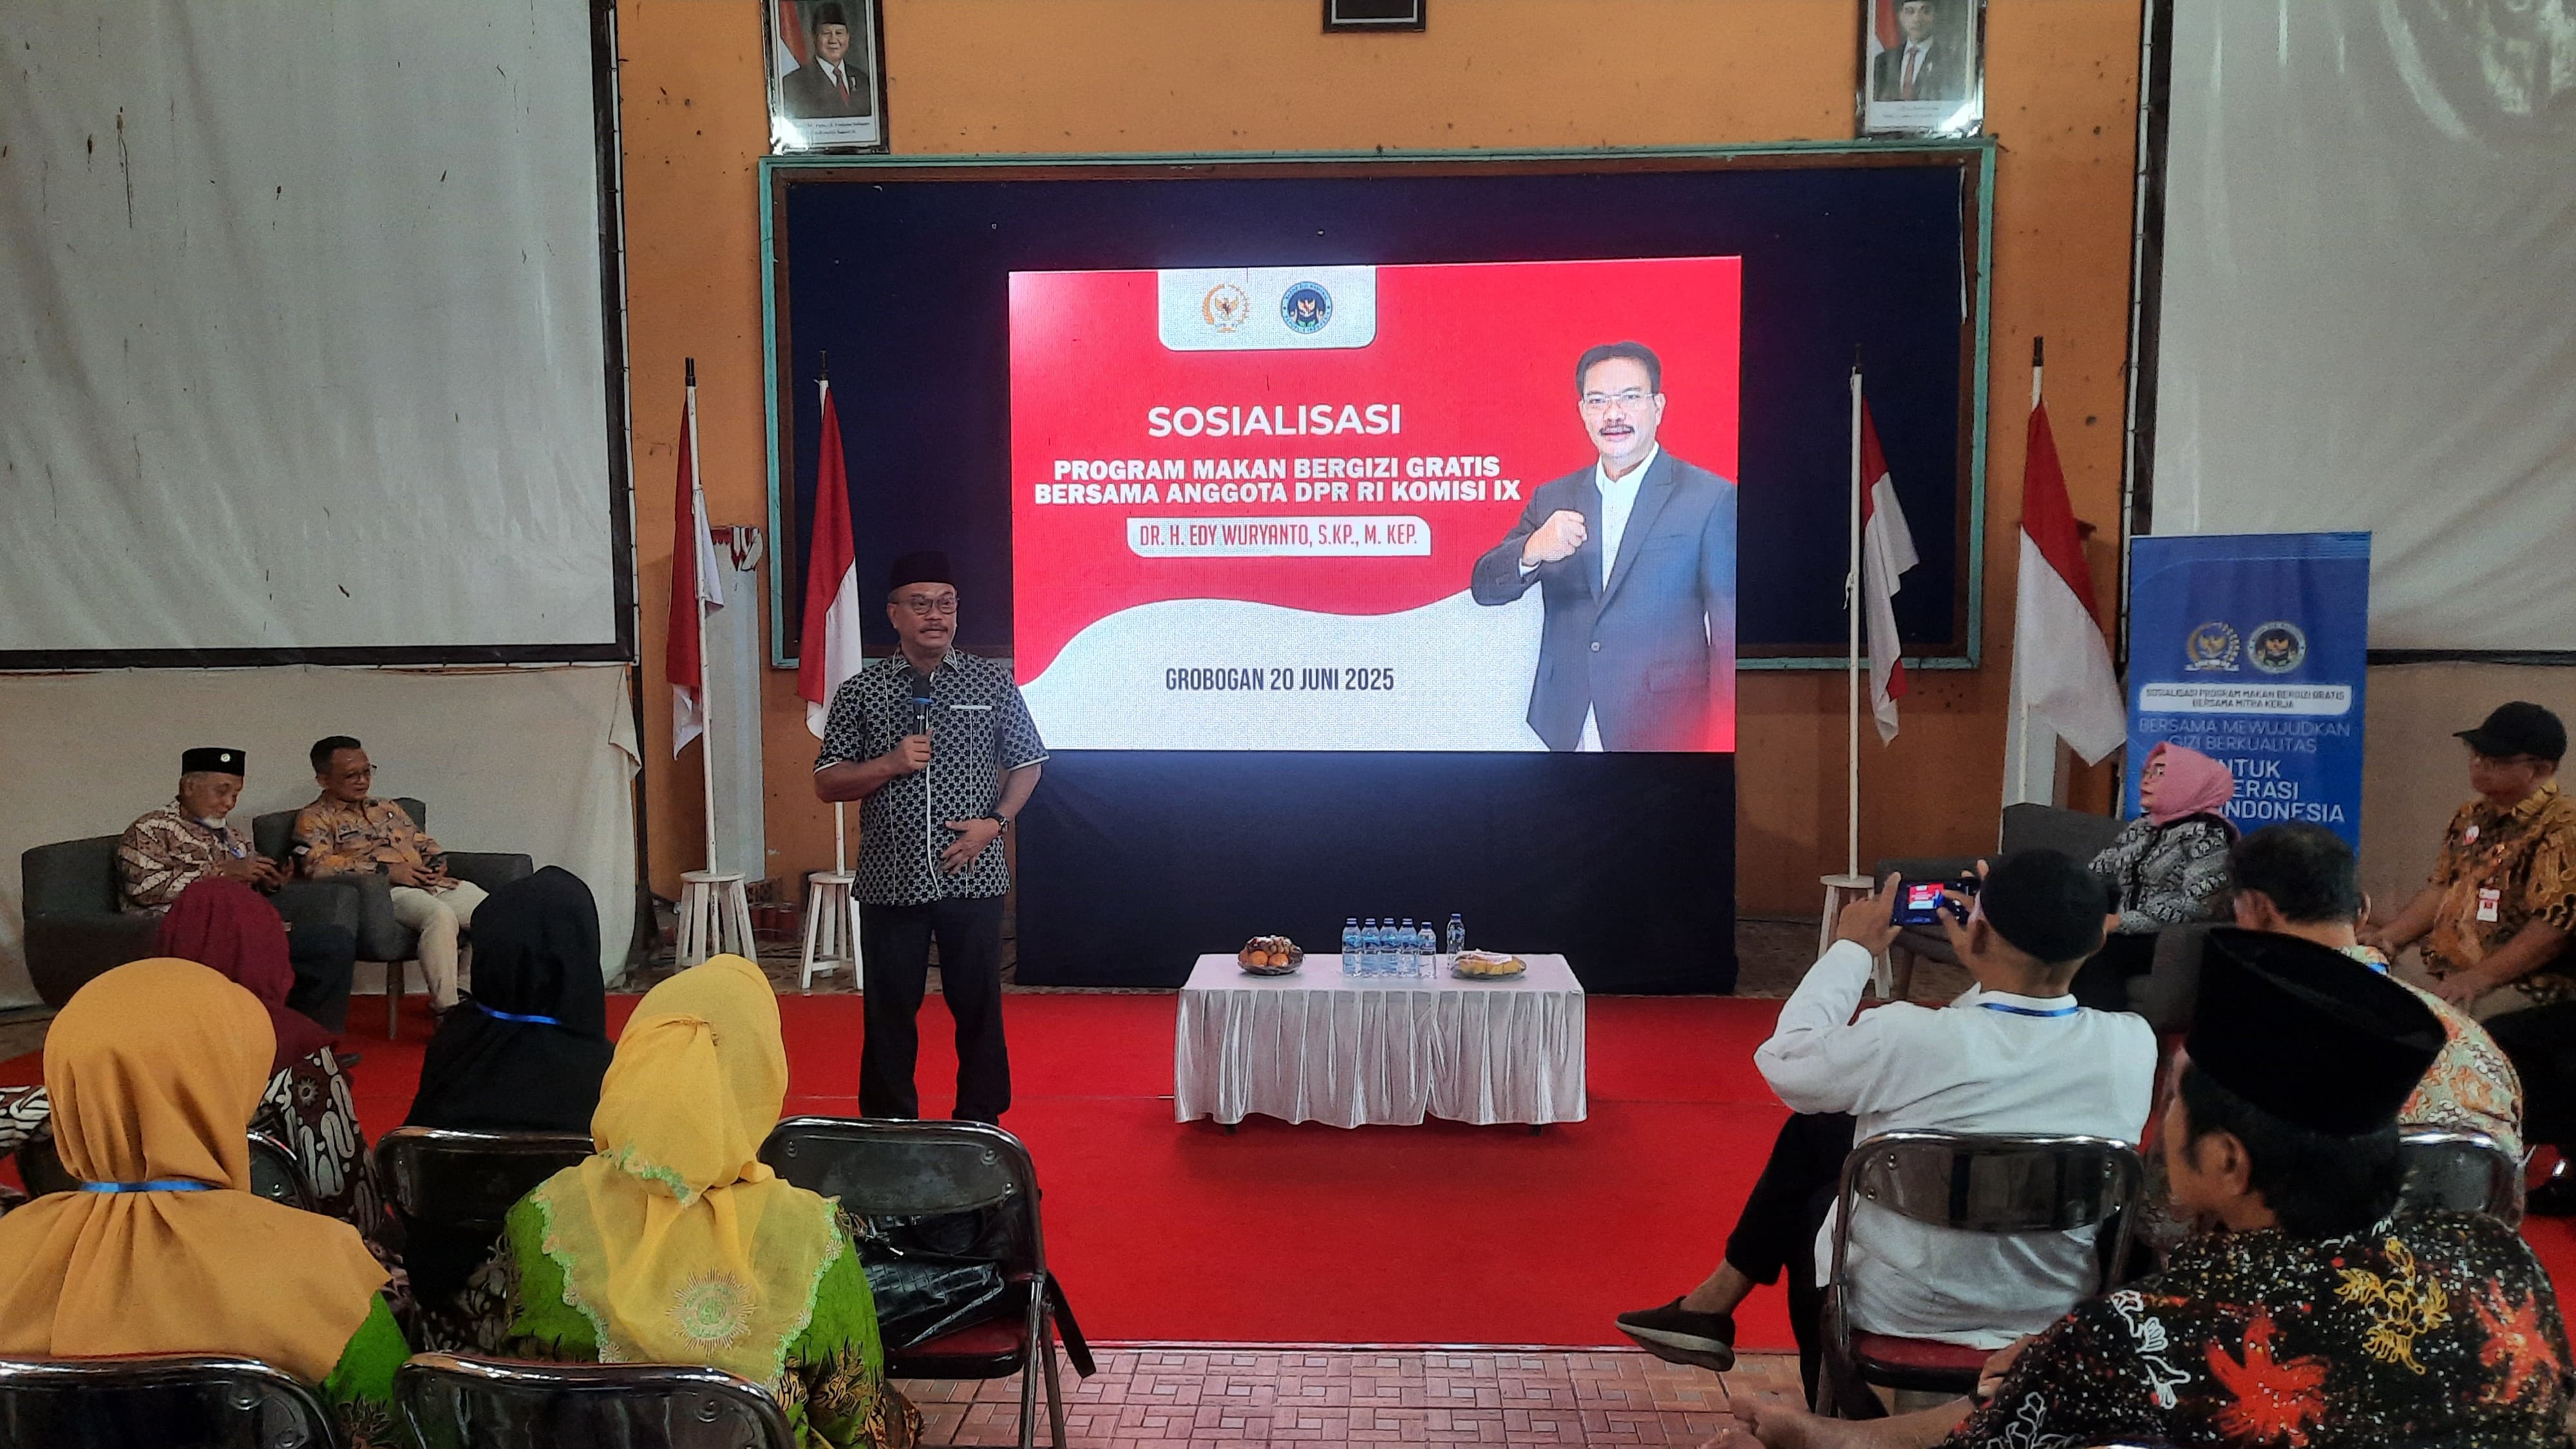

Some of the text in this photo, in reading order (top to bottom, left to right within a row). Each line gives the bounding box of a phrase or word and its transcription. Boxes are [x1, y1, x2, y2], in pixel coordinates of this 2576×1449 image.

[1148, 404, 1401, 438] SOSIALISASI
[1054, 456, 1500, 480] PROGRAM MAKAN BERGIZI GRATIS
[1034, 479, 1521, 505] BERSAMA ANGGOTA DPR RI KOMISI IX
[1140, 524, 1417, 547] DR. H. EDY WURYANTO, S.KP., M. KEP.
[1166, 667, 1395, 691] GROBOGAN 20 JUNI 2025
[2242, 689, 2275, 699] MAKAN
[2139, 717, 2217, 734] BERSAMA
[2168, 734, 2318, 753] GIZI BERKUALITAS
[2232, 779, 2300, 800] ERASI
